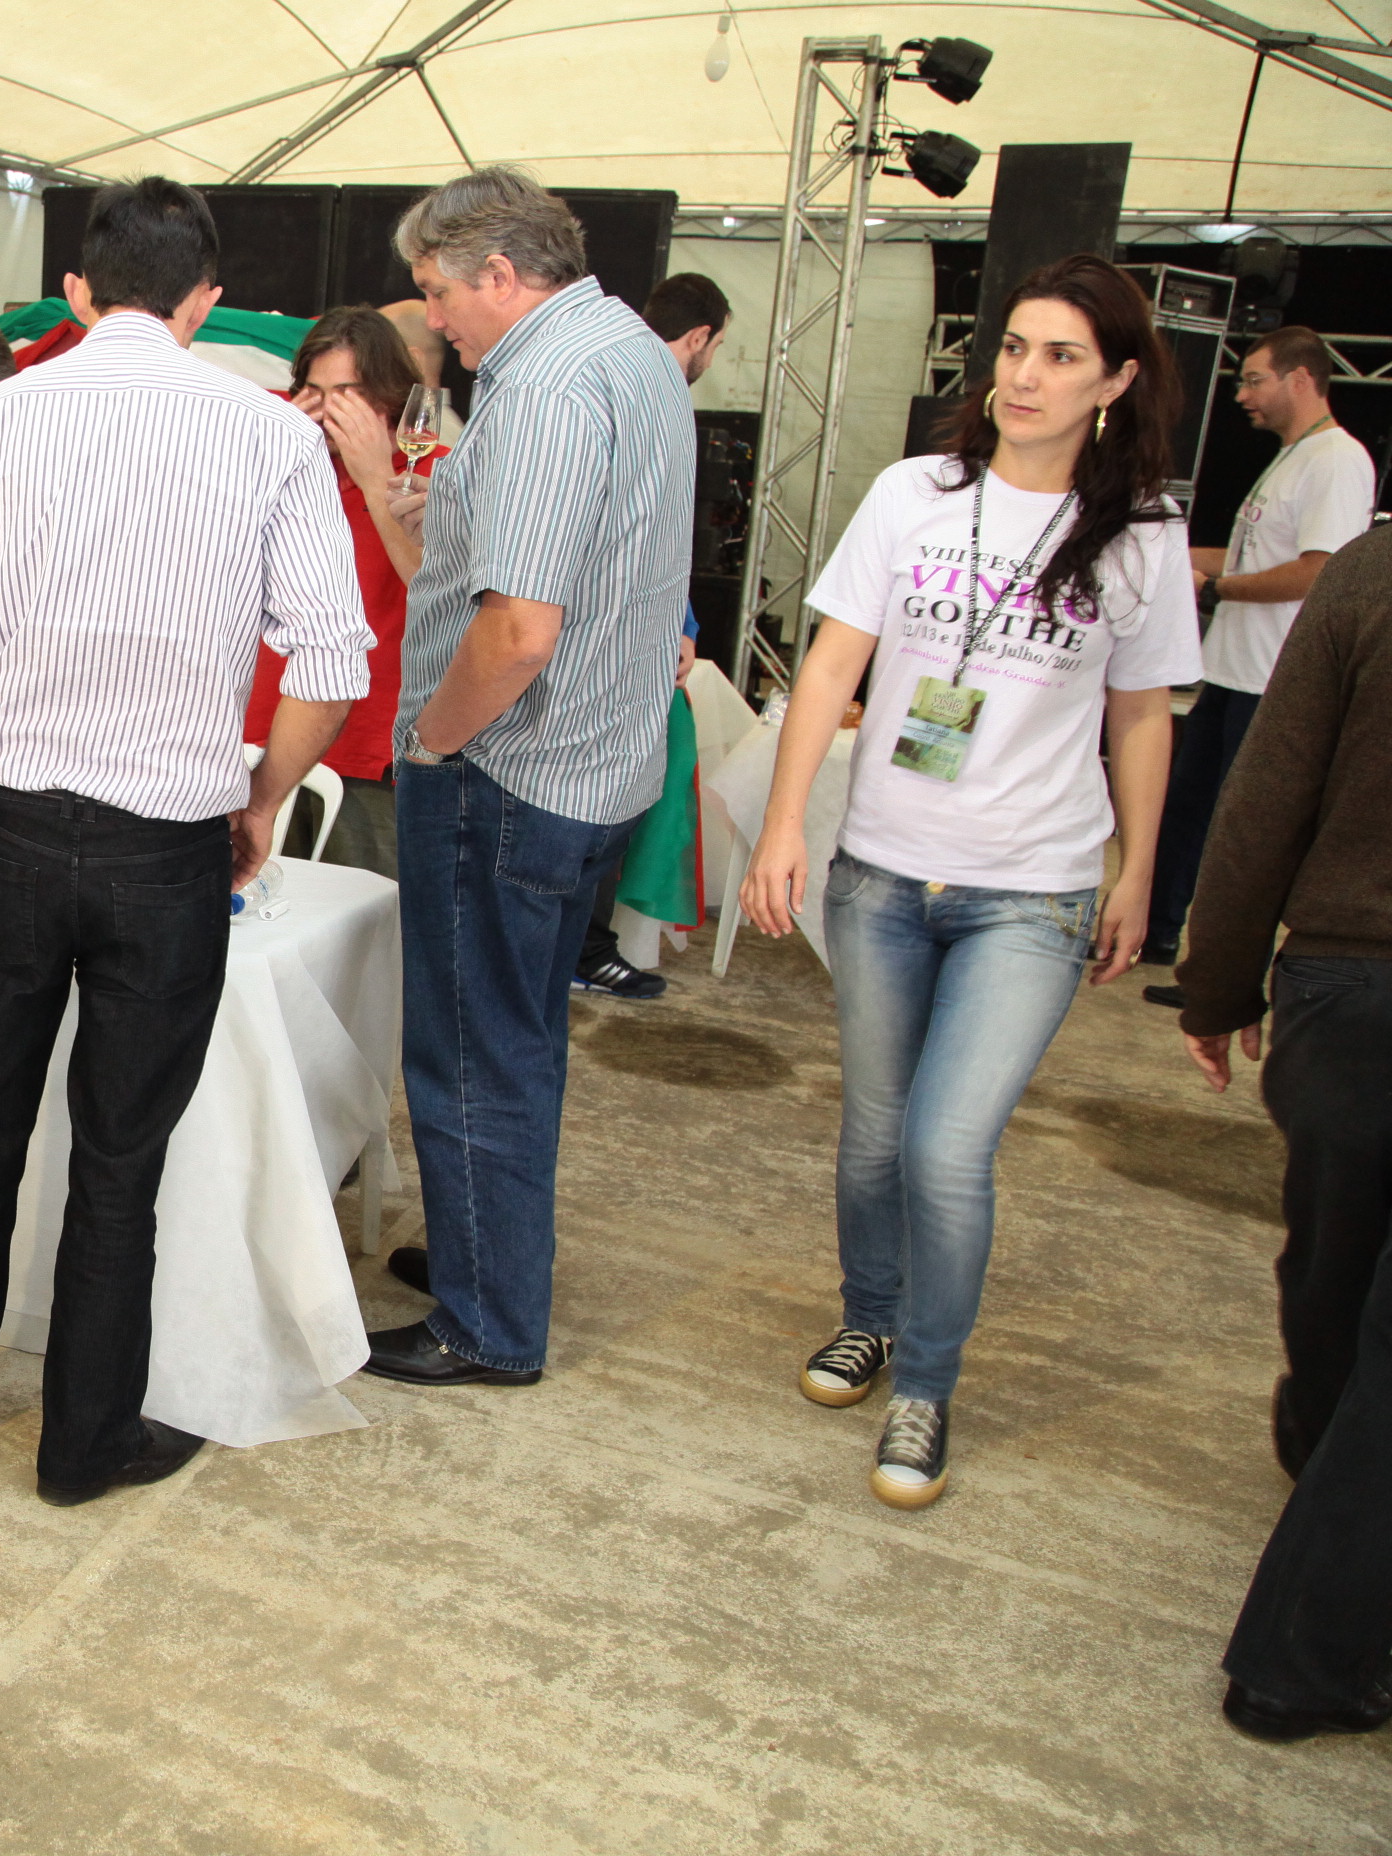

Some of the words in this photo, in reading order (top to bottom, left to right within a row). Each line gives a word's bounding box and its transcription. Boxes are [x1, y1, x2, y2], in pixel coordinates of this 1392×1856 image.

[919, 544, 968, 564] VIII
[902, 622, 937, 643] 12/13
[940, 632, 950, 644] e
[979, 638, 997, 655] de
[934, 697, 963, 710] VINHO
